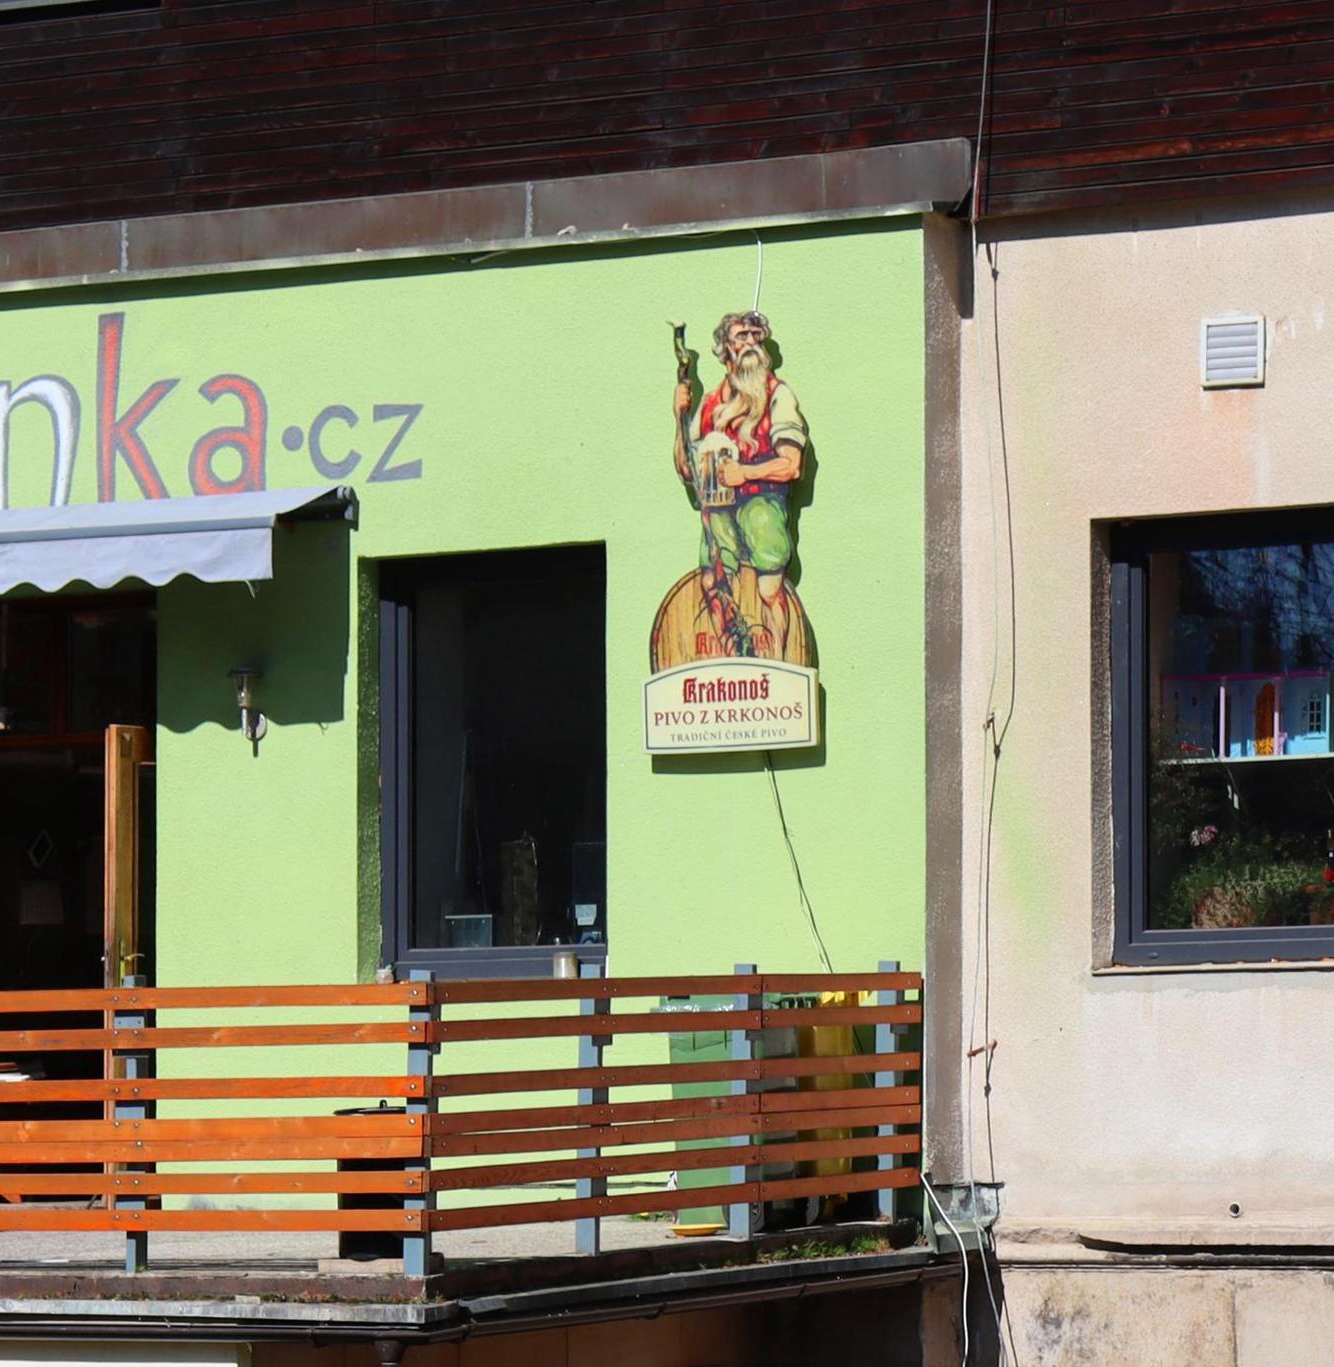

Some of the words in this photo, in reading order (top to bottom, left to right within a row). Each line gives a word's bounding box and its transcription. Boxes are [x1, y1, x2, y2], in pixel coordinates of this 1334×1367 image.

[682, 673, 770, 704] Krakonoš
[653, 710, 695, 726] PIVO
[700, 709, 709, 724] Z
[715, 702, 803, 723] KRKONOŠ
[670, 730, 722, 742] TRADIČNÍ
[725, 728, 757, 740] ČESKÉ
[761, 727, 787, 738] PIVO
